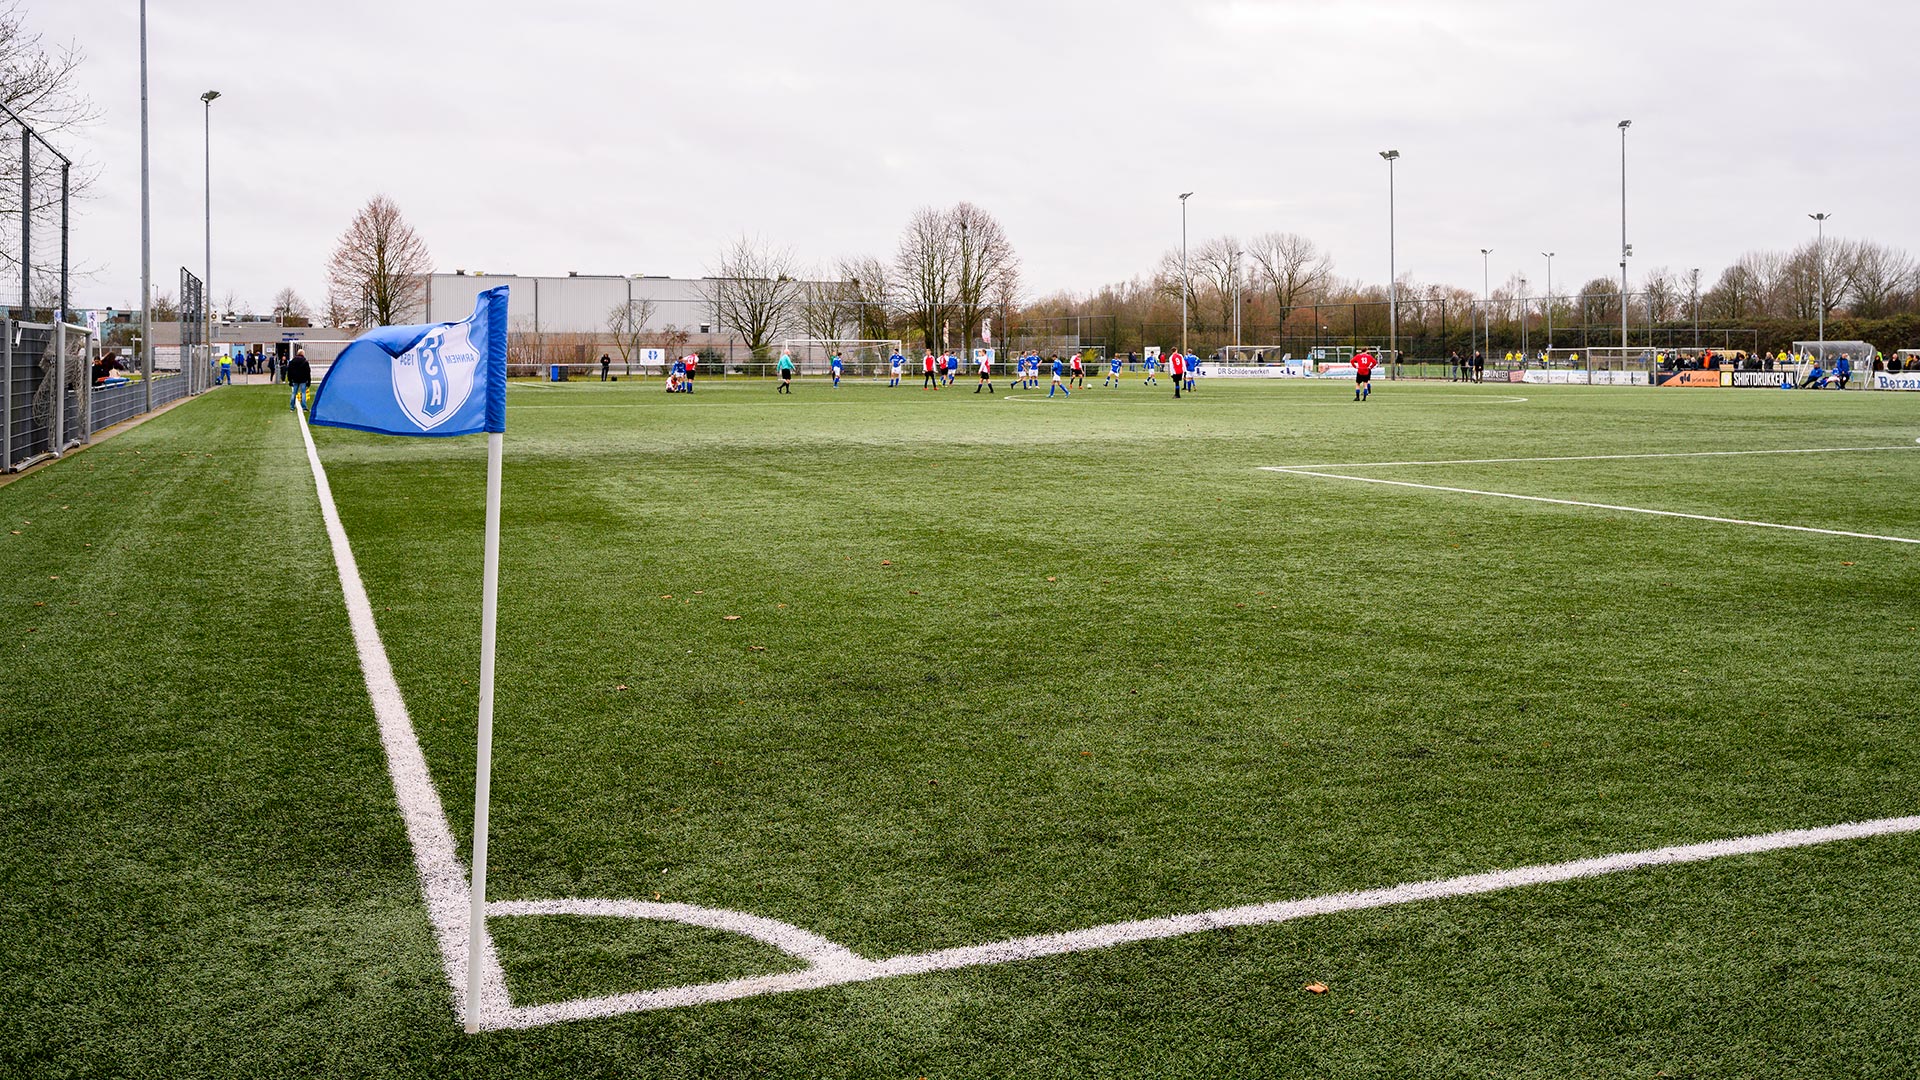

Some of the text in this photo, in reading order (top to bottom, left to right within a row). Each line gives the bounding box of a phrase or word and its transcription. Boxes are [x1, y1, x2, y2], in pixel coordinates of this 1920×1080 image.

[1175, 357, 1181, 366] 9
[1361, 357, 1368, 365] 13
[1218, 367, 1270, 375] DR Schilderwerken
[1734, 372, 1795, 386] SHIRTDRUKKERNL
